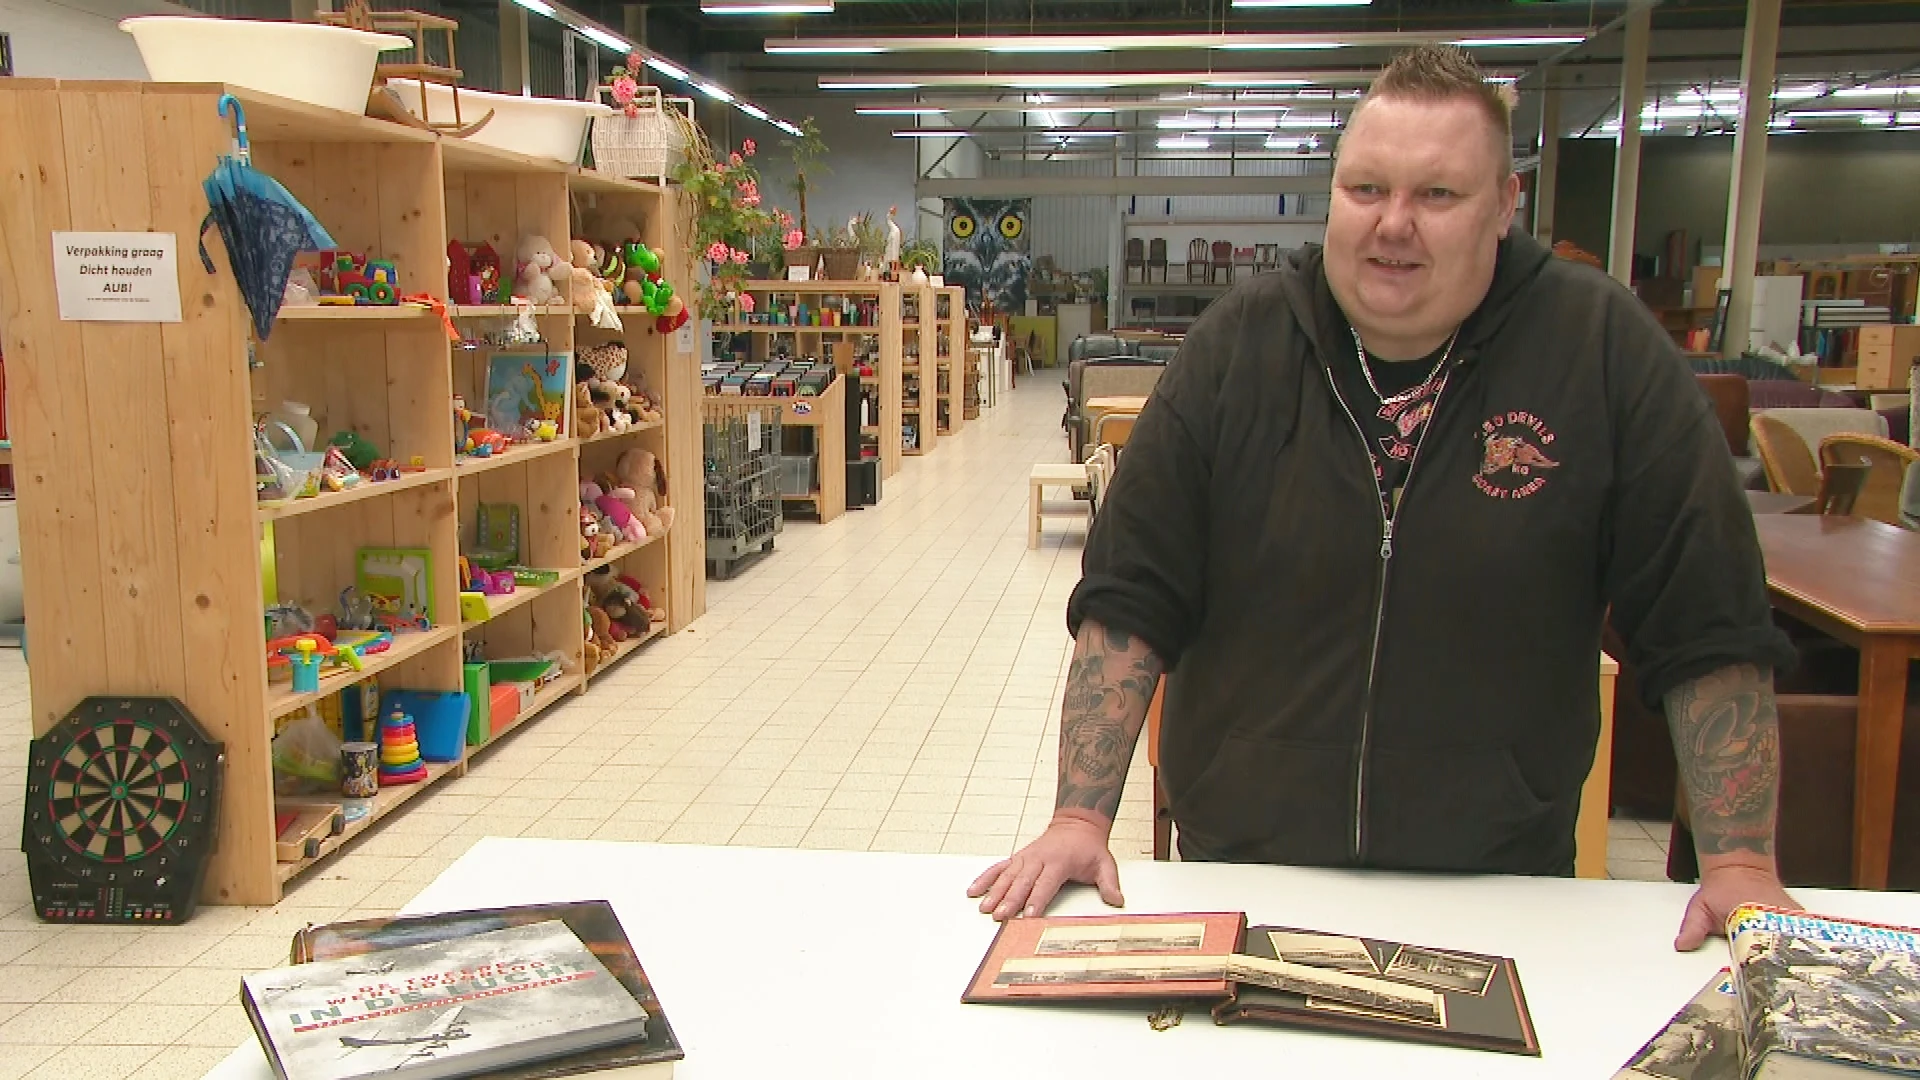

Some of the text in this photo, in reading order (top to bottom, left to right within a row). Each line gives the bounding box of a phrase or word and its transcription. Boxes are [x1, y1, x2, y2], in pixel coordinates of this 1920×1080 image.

[66, 245, 164, 259] Verpakking graag
[79, 264, 152, 276] Dicht houden
[1507, 411, 1554, 445] DEVILS
[289, 960, 587, 1026] IN DE LUCHT
